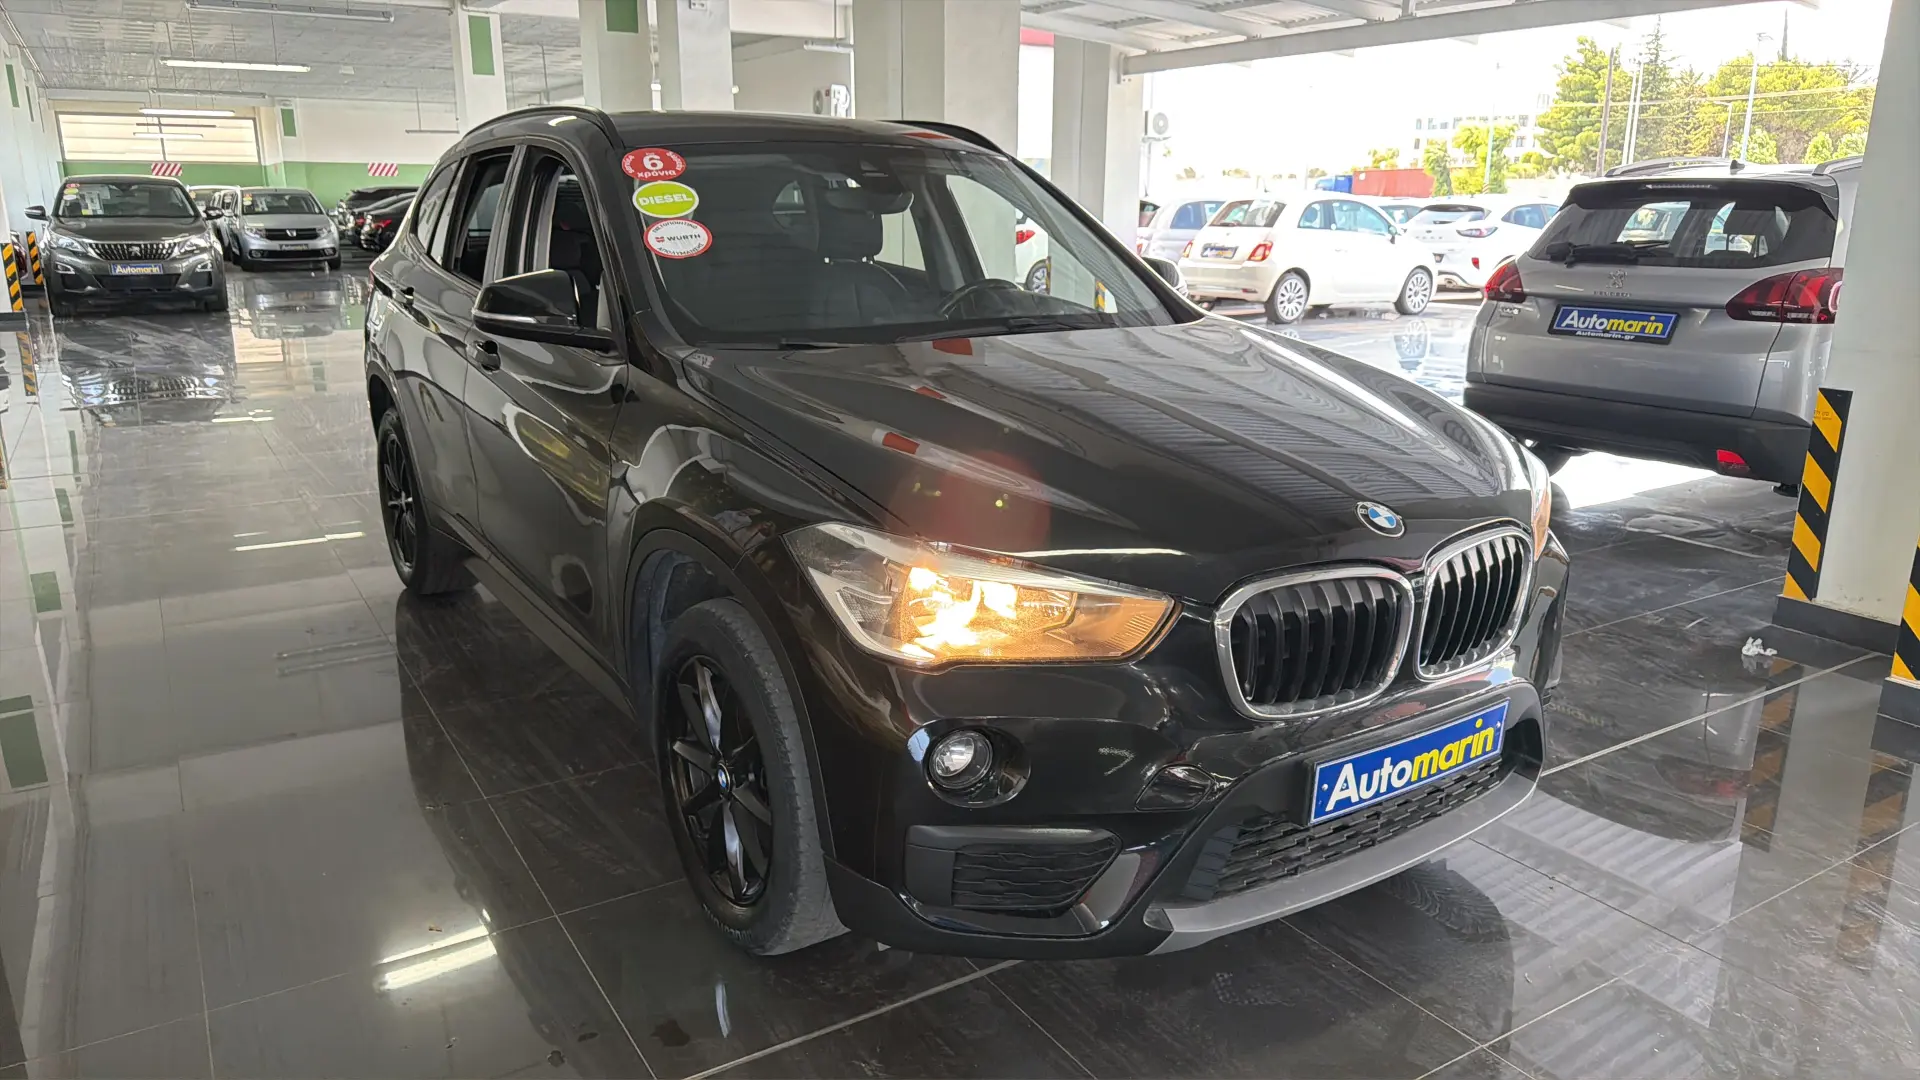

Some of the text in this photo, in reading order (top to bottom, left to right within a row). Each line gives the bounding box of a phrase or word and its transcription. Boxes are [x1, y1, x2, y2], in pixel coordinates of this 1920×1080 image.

[642, 154, 664, 171] 6
[637, 169, 677, 179] χρόνια
[638, 193, 693, 206] DIESEL
[1561, 309, 1664, 335] Automarin
[1325, 718, 1495, 812] Automarin
